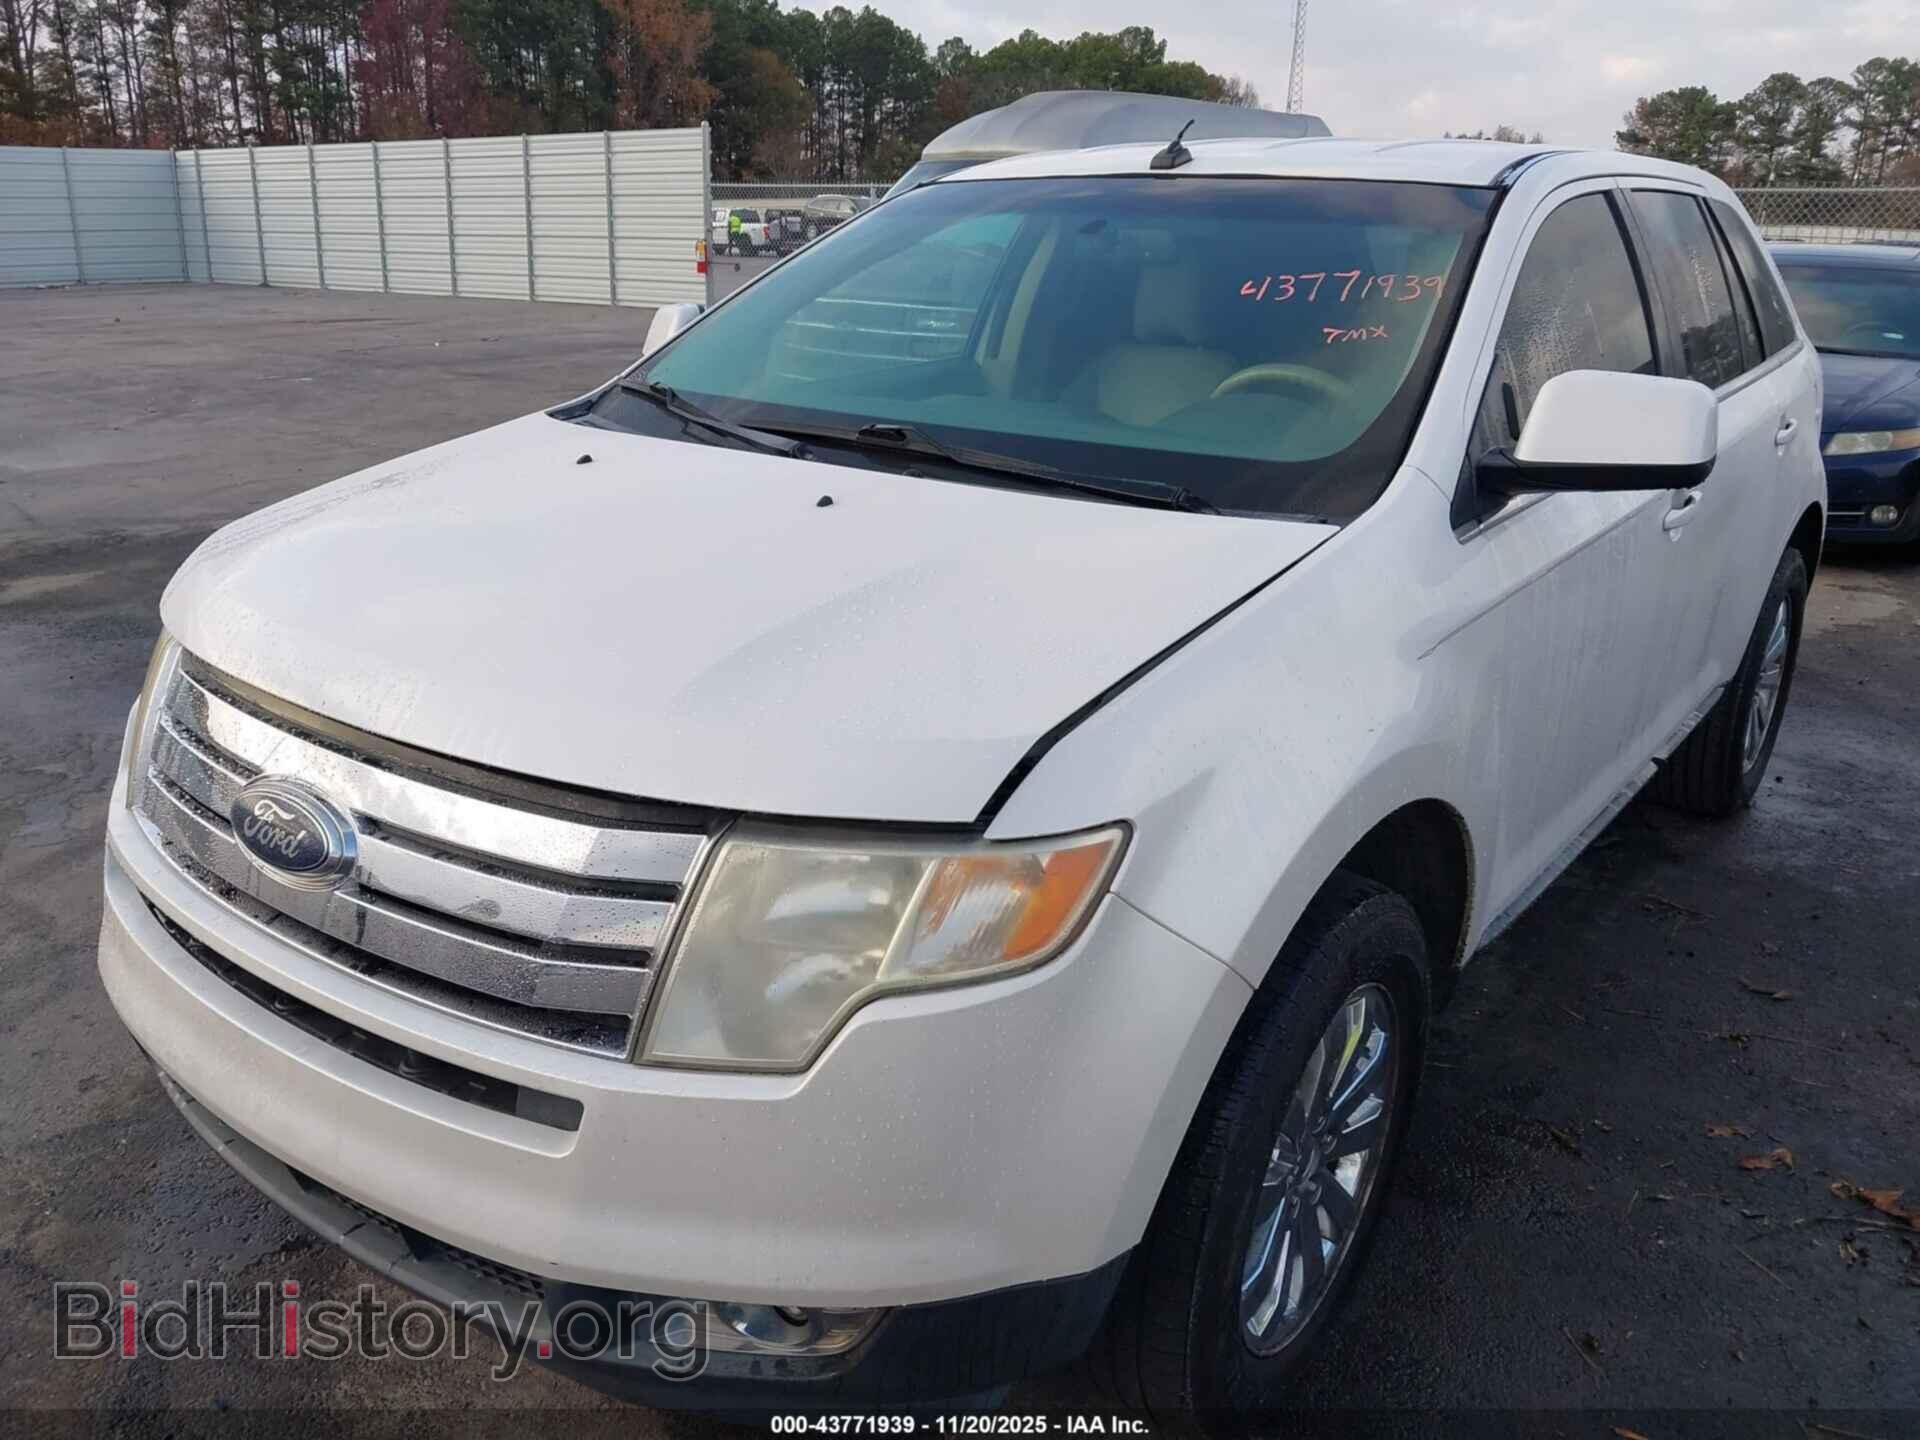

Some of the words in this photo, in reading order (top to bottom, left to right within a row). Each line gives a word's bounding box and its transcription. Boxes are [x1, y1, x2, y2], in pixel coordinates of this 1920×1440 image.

[1240, 269, 1446, 302] 43771939
[1322, 324, 1389, 344] TMX
[244, 800, 307, 858] Ford
